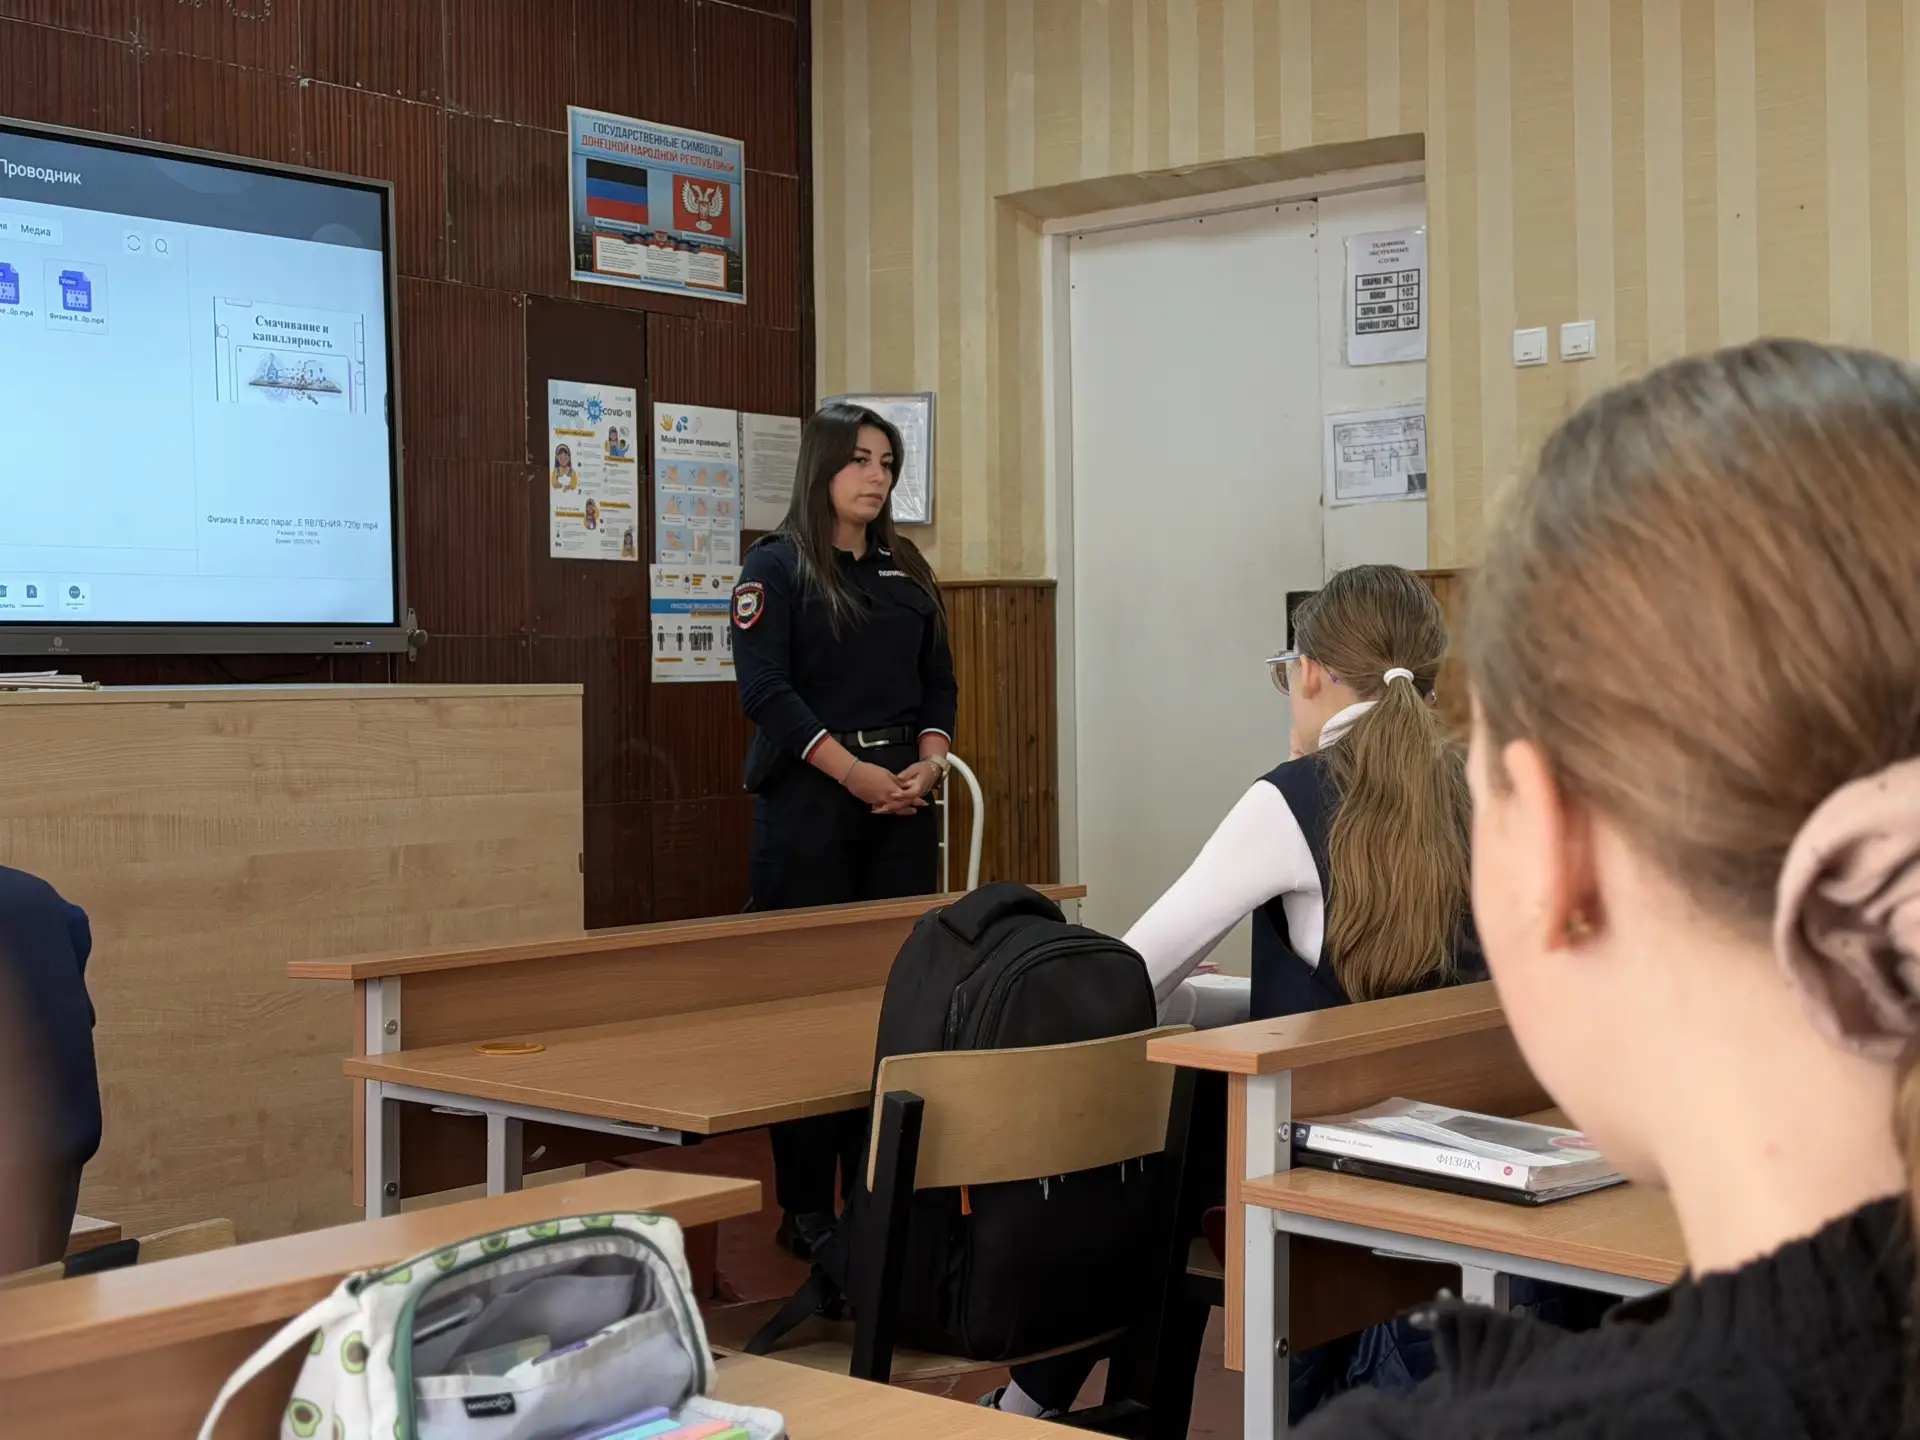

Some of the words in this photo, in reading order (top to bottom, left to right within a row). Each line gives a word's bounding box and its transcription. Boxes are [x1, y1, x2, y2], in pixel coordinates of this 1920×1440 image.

[593, 122, 679, 149] ГОСУДАРСТВЕННЫЕ
[681, 139, 723, 157] СИМВОЛЫ
[581, 134, 629, 153] ДОНЕЦКОЙ
[631, 143, 678, 162] НАРОДНОЙ
[680, 153, 735, 173] РЕСПУБЛИКИ
[0, 158, 82, 185] Проводник
[20, 223, 51, 237] Медиа
[1402, 273, 1414, 284] 101
[1402, 287, 1415, 297] 102
[1402, 301, 1415, 312] 103
[255, 315, 321, 333] Смачивание
[322, 325, 329, 334] и
[1402, 315, 1415, 327] 104
[252, 332, 333, 348] капиллярность
[552, 397, 585, 409] МОЛОДЫЕ
[559, 408, 580, 418] ЛЮДИ
[590, 407, 600, 416] VS
[602, 407, 632, 418] COVID-19
[660, 434, 677, 444] Мой
[207, 515, 238, 525] Физика
[246, 517, 270, 526] класс
[1436, 1153, 1481, 1171] ФИЗИКА
